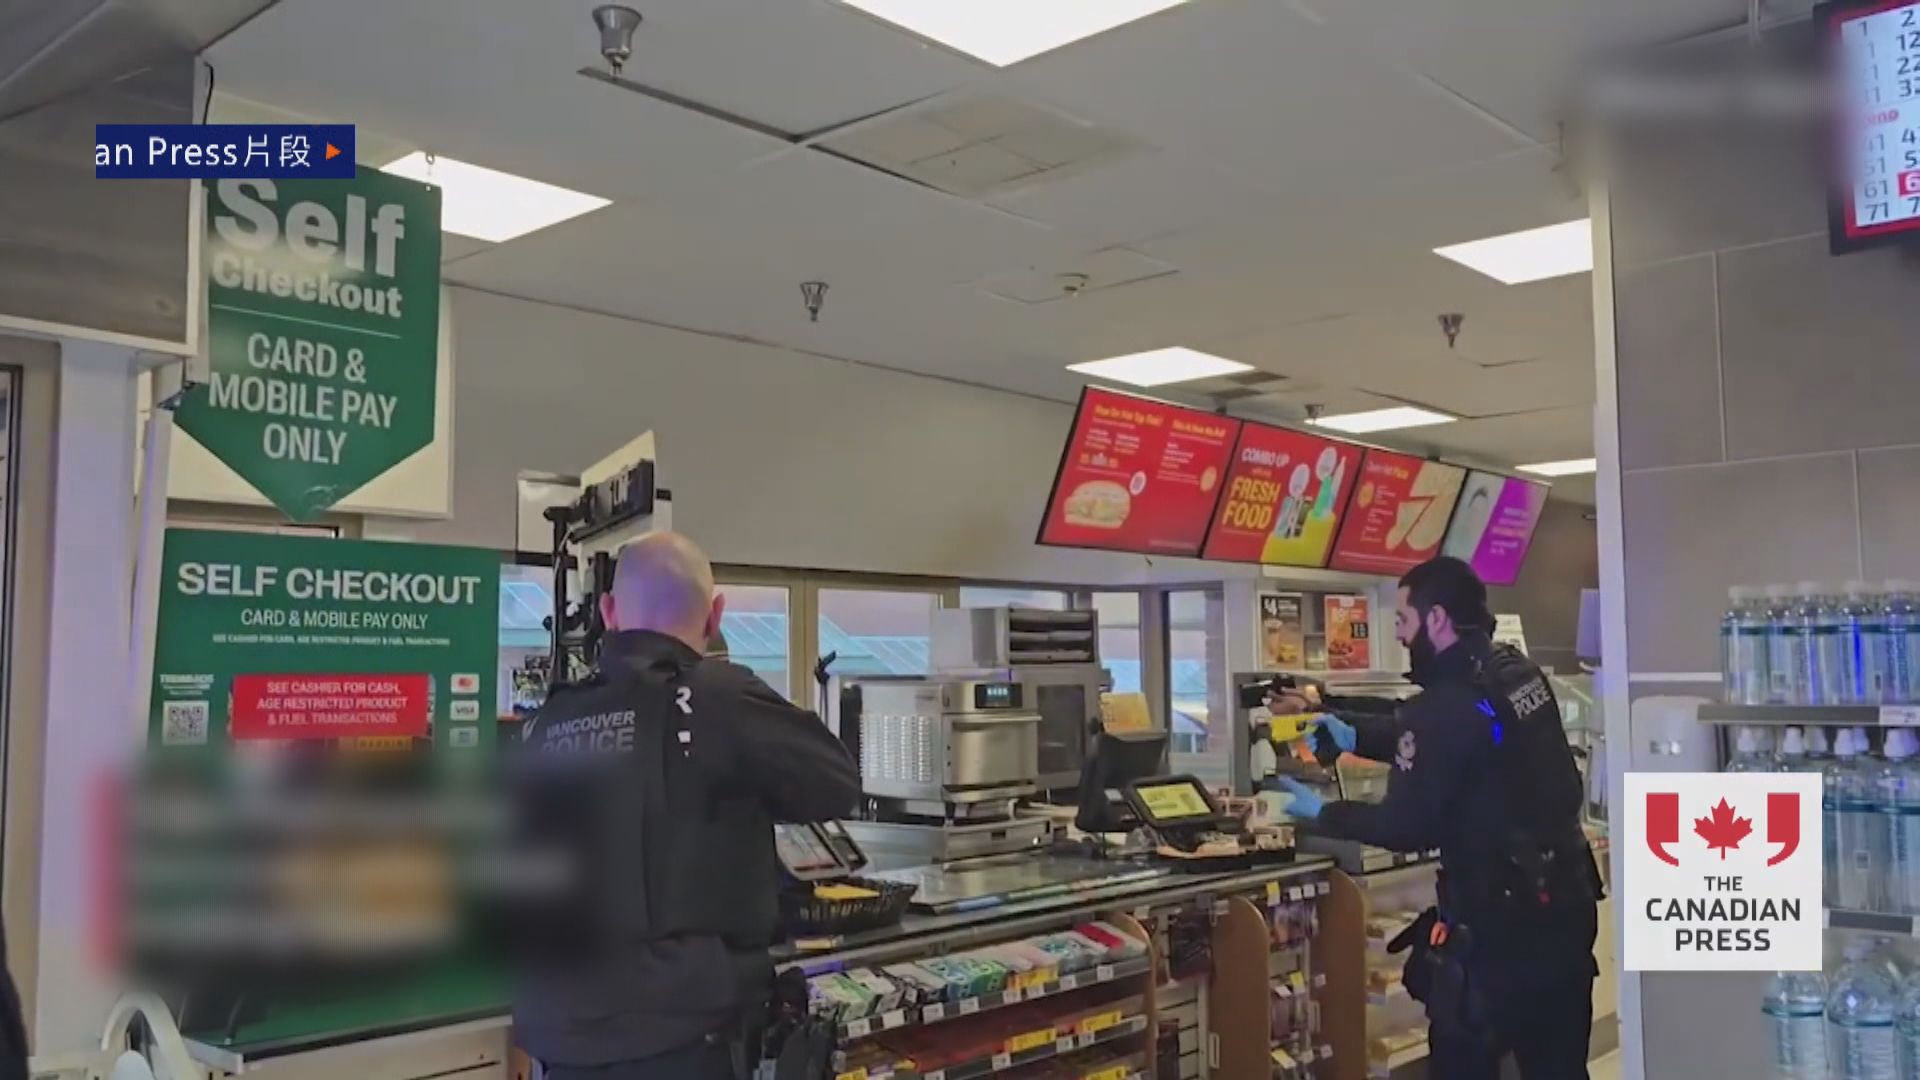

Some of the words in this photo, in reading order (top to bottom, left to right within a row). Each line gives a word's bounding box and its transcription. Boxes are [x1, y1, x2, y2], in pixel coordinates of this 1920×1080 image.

[1900, 10, 1915, 28] 2
[1896, 31, 1920, 51] 12
[1901, 126, 1920, 144] 4
[1904, 151, 1920, 168] 5
[1864, 180, 1888, 199] 61
[1864, 202, 1889, 221] 71
[214, 178, 405, 278] Self
[212, 251, 403, 318] Checkout
[247, 332, 338, 379] CARD
[344, 348, 367, 384] &
[209, 371, 335, 422] MOBILE
[341, 388, 398, 430] PAY
[263, 421, 348, 465] ONLY
[1230, 476, 1282, 503] FRESH
[1222, 500, 1273, 530] FOOD
[177, 561, 278, 597] SELF
[286, 567, 482, 605] CHECKOUT
[241, 608, 286, 627] CARD
[289, 610, 301, 627] &
[303, 610, 360, 628] MOBILE
[363, 612, 391, 629] PAY
[392, 613, 429, 630] ONLY
[266, 681, 290, 694] SEE
[291, 681, 341, 694] CASHIER
[343, 681, 367, 694] FOR
[256, 697, 281, 711] AGE
[283, 697, 354, 711] RESTRICTED
[356, 697, 409, 711] PRODUCT
[1513, 686, 1551, 720] POLICE
[279, 713, 309, 725] FUEL
[311, 712, 397, 724] TRANSACTIONS
[546, 710, 636, 741] VANCOUVER
